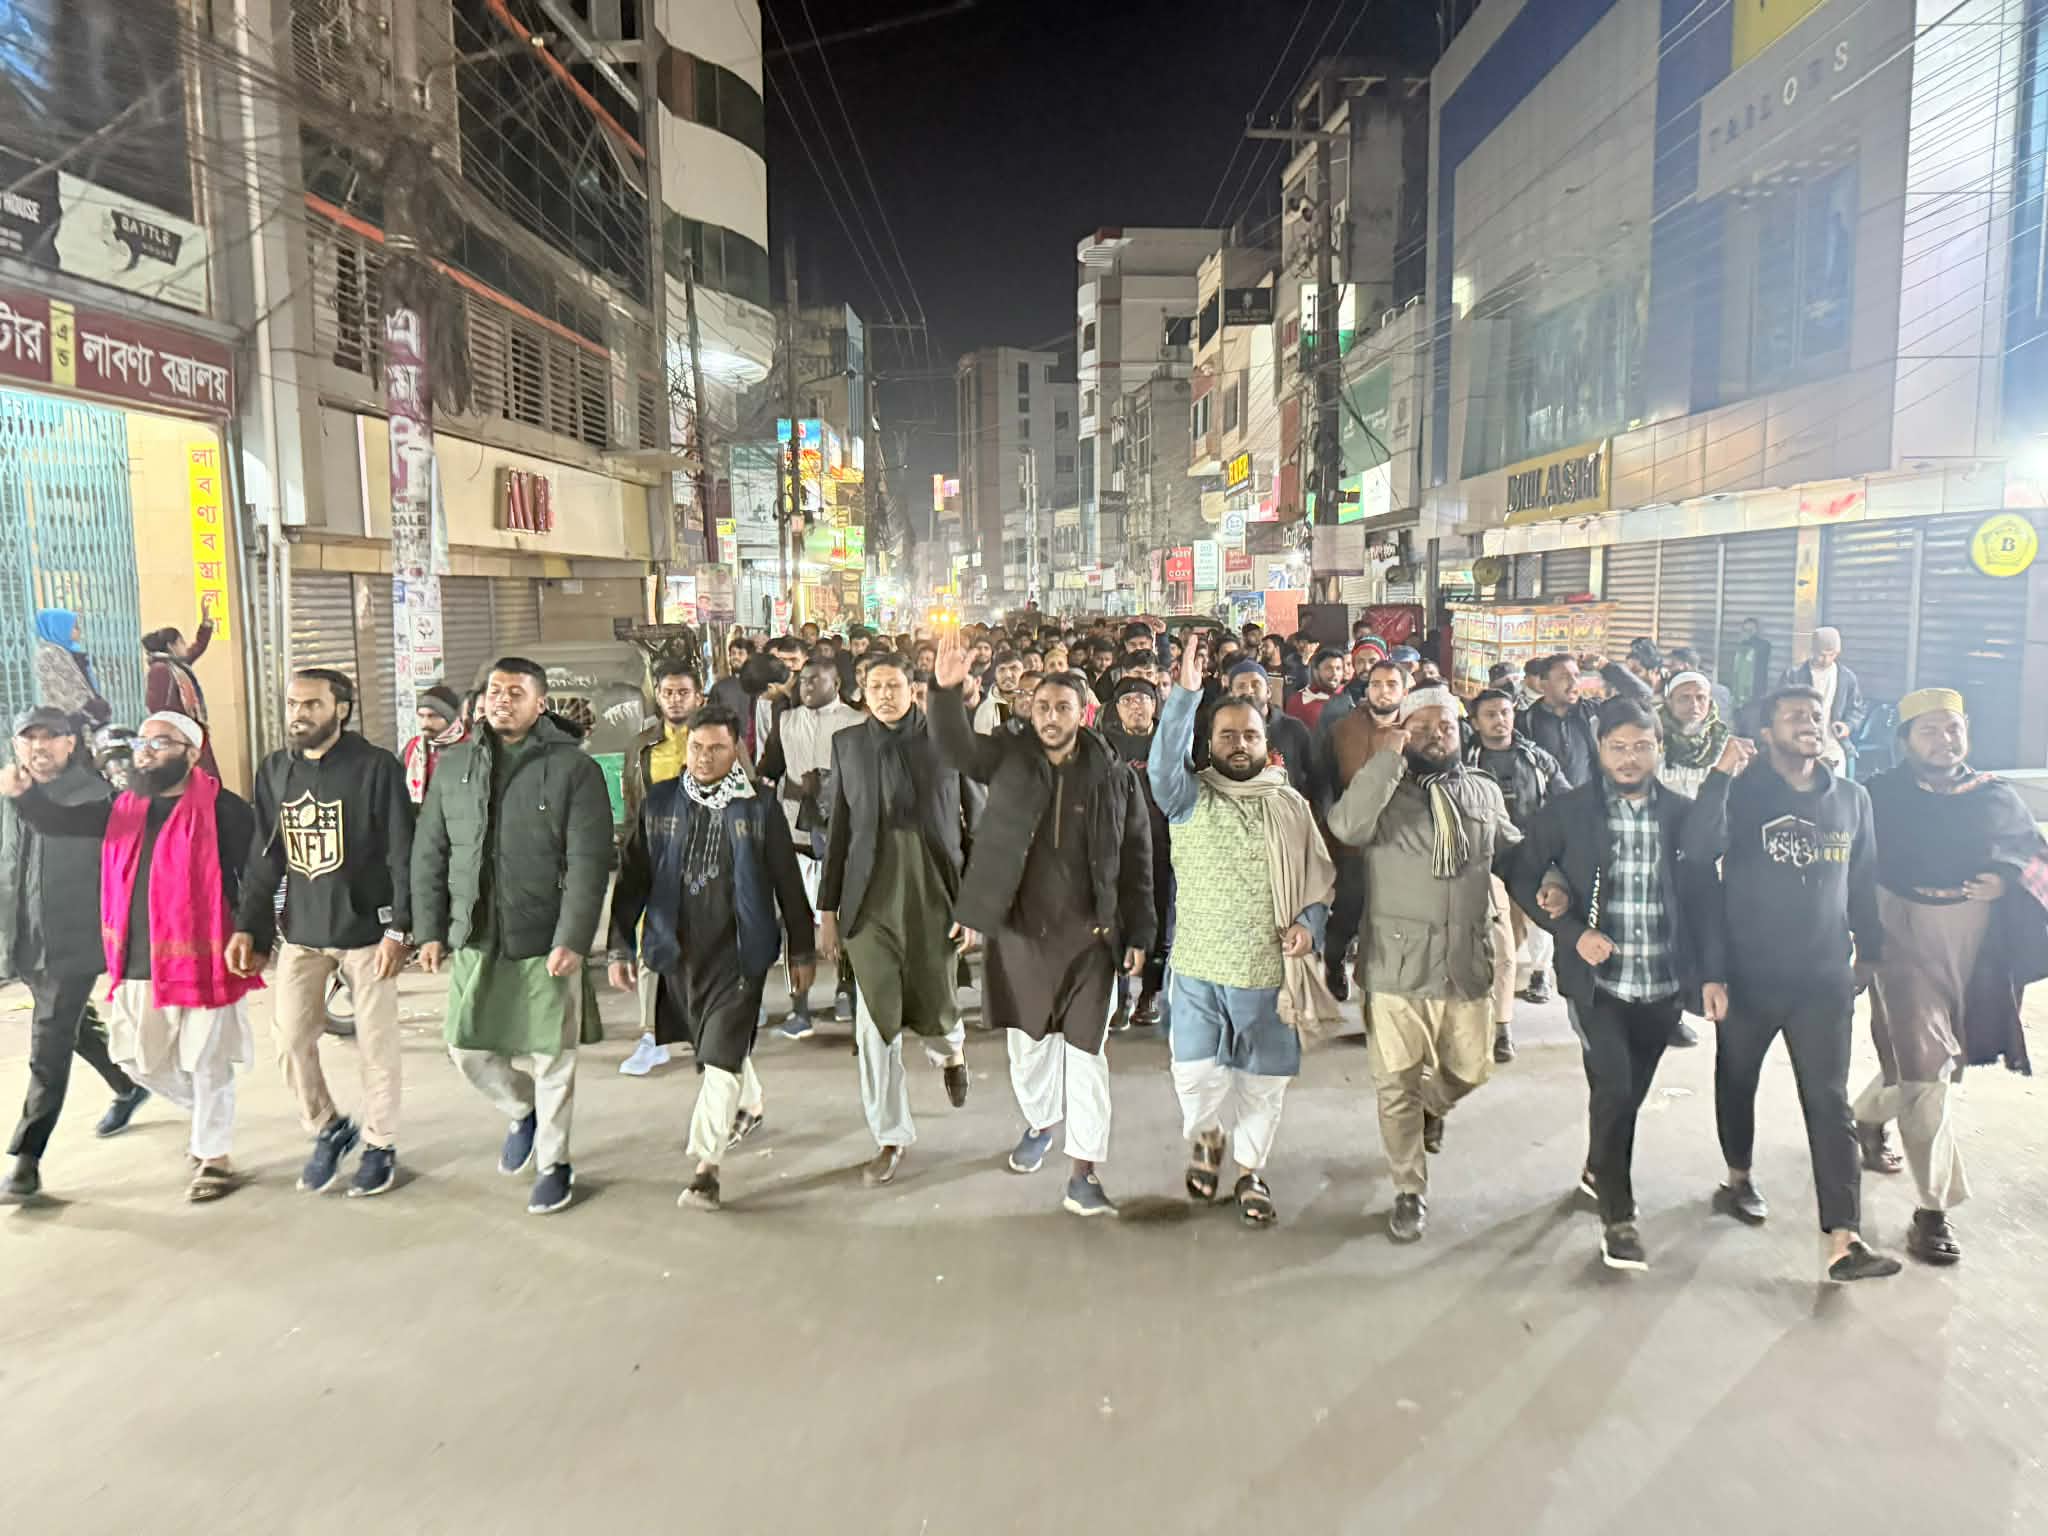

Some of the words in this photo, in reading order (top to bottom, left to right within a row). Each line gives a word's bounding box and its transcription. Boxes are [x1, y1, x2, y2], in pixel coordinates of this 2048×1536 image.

[120, 214, 172, 247] BATTLE
[80, 331, 154, 388] লাবণ্য
[159, 351, 229, 403] বস্ত্রালয়
[391, 514, 427, 527] SALE
[287, 831, 334, 869] NFL
